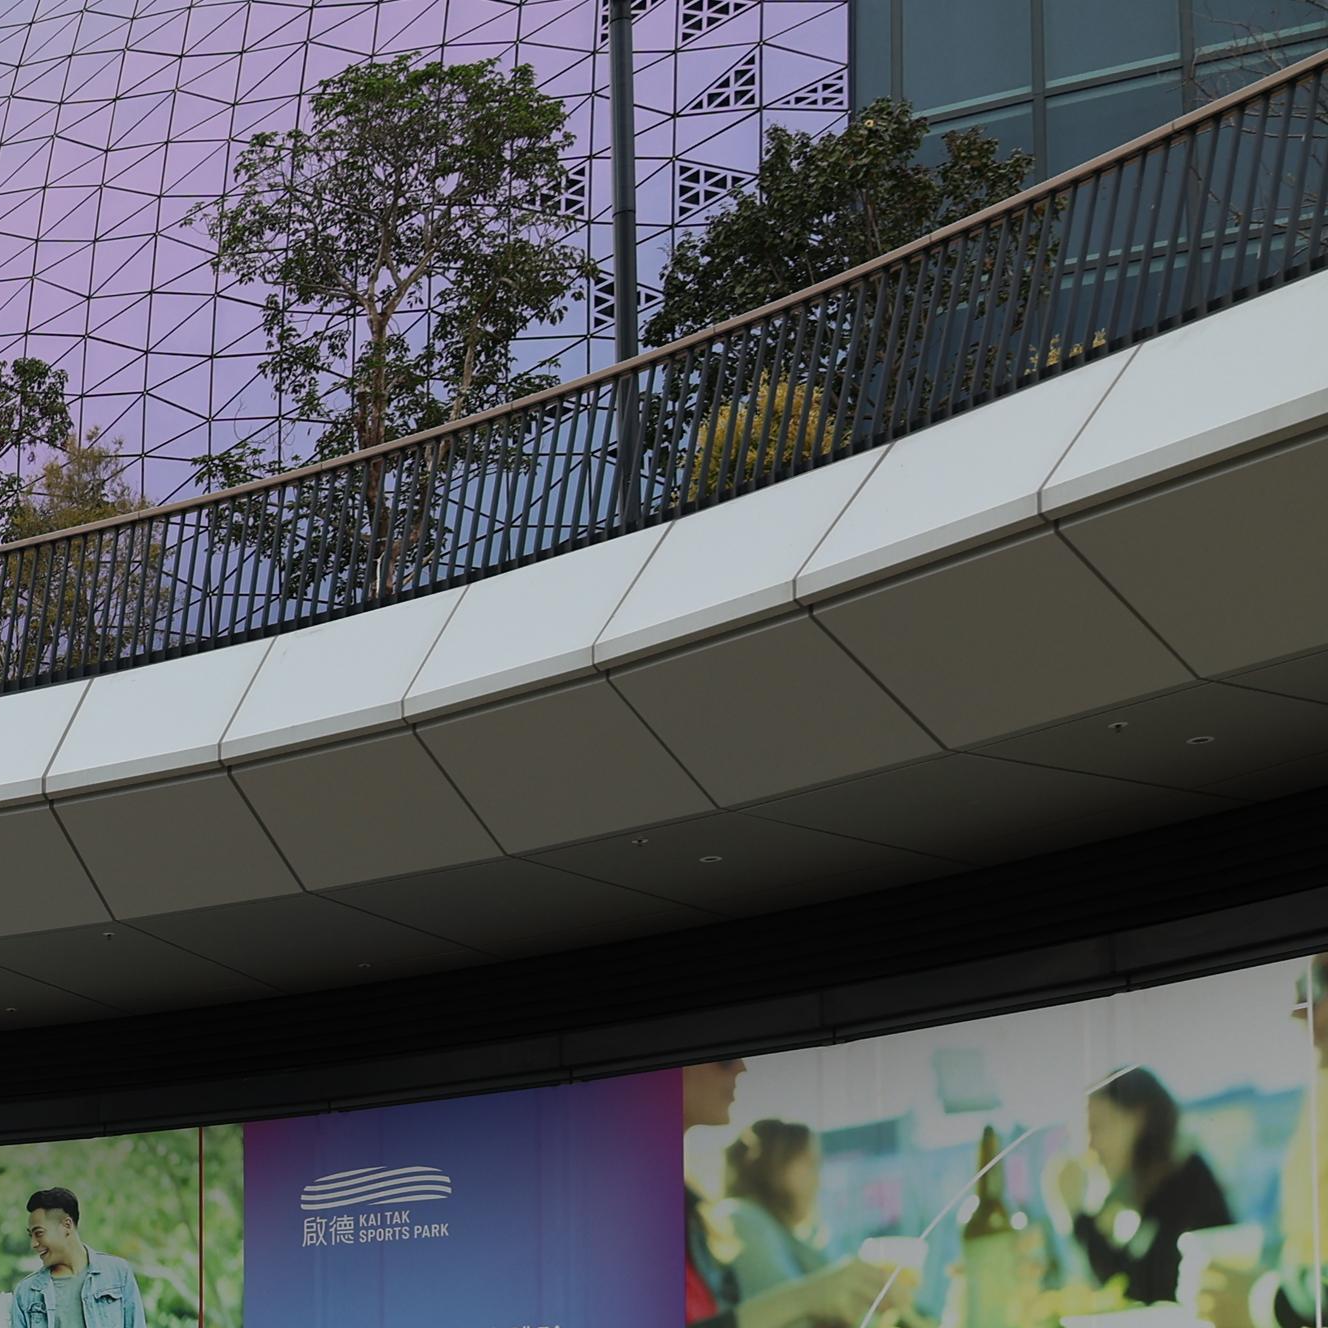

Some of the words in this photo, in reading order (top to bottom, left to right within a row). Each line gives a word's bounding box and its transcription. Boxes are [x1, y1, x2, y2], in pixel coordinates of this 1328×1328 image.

[359, 1213, 381, 1227] KAI
[385, 1210, 410, 1225] TAK
[302, 1214, 355, 1247] 啟德
[359, 1227, 410, 1243] SPORTS
[414, 1223, 449, 1239] PARK
